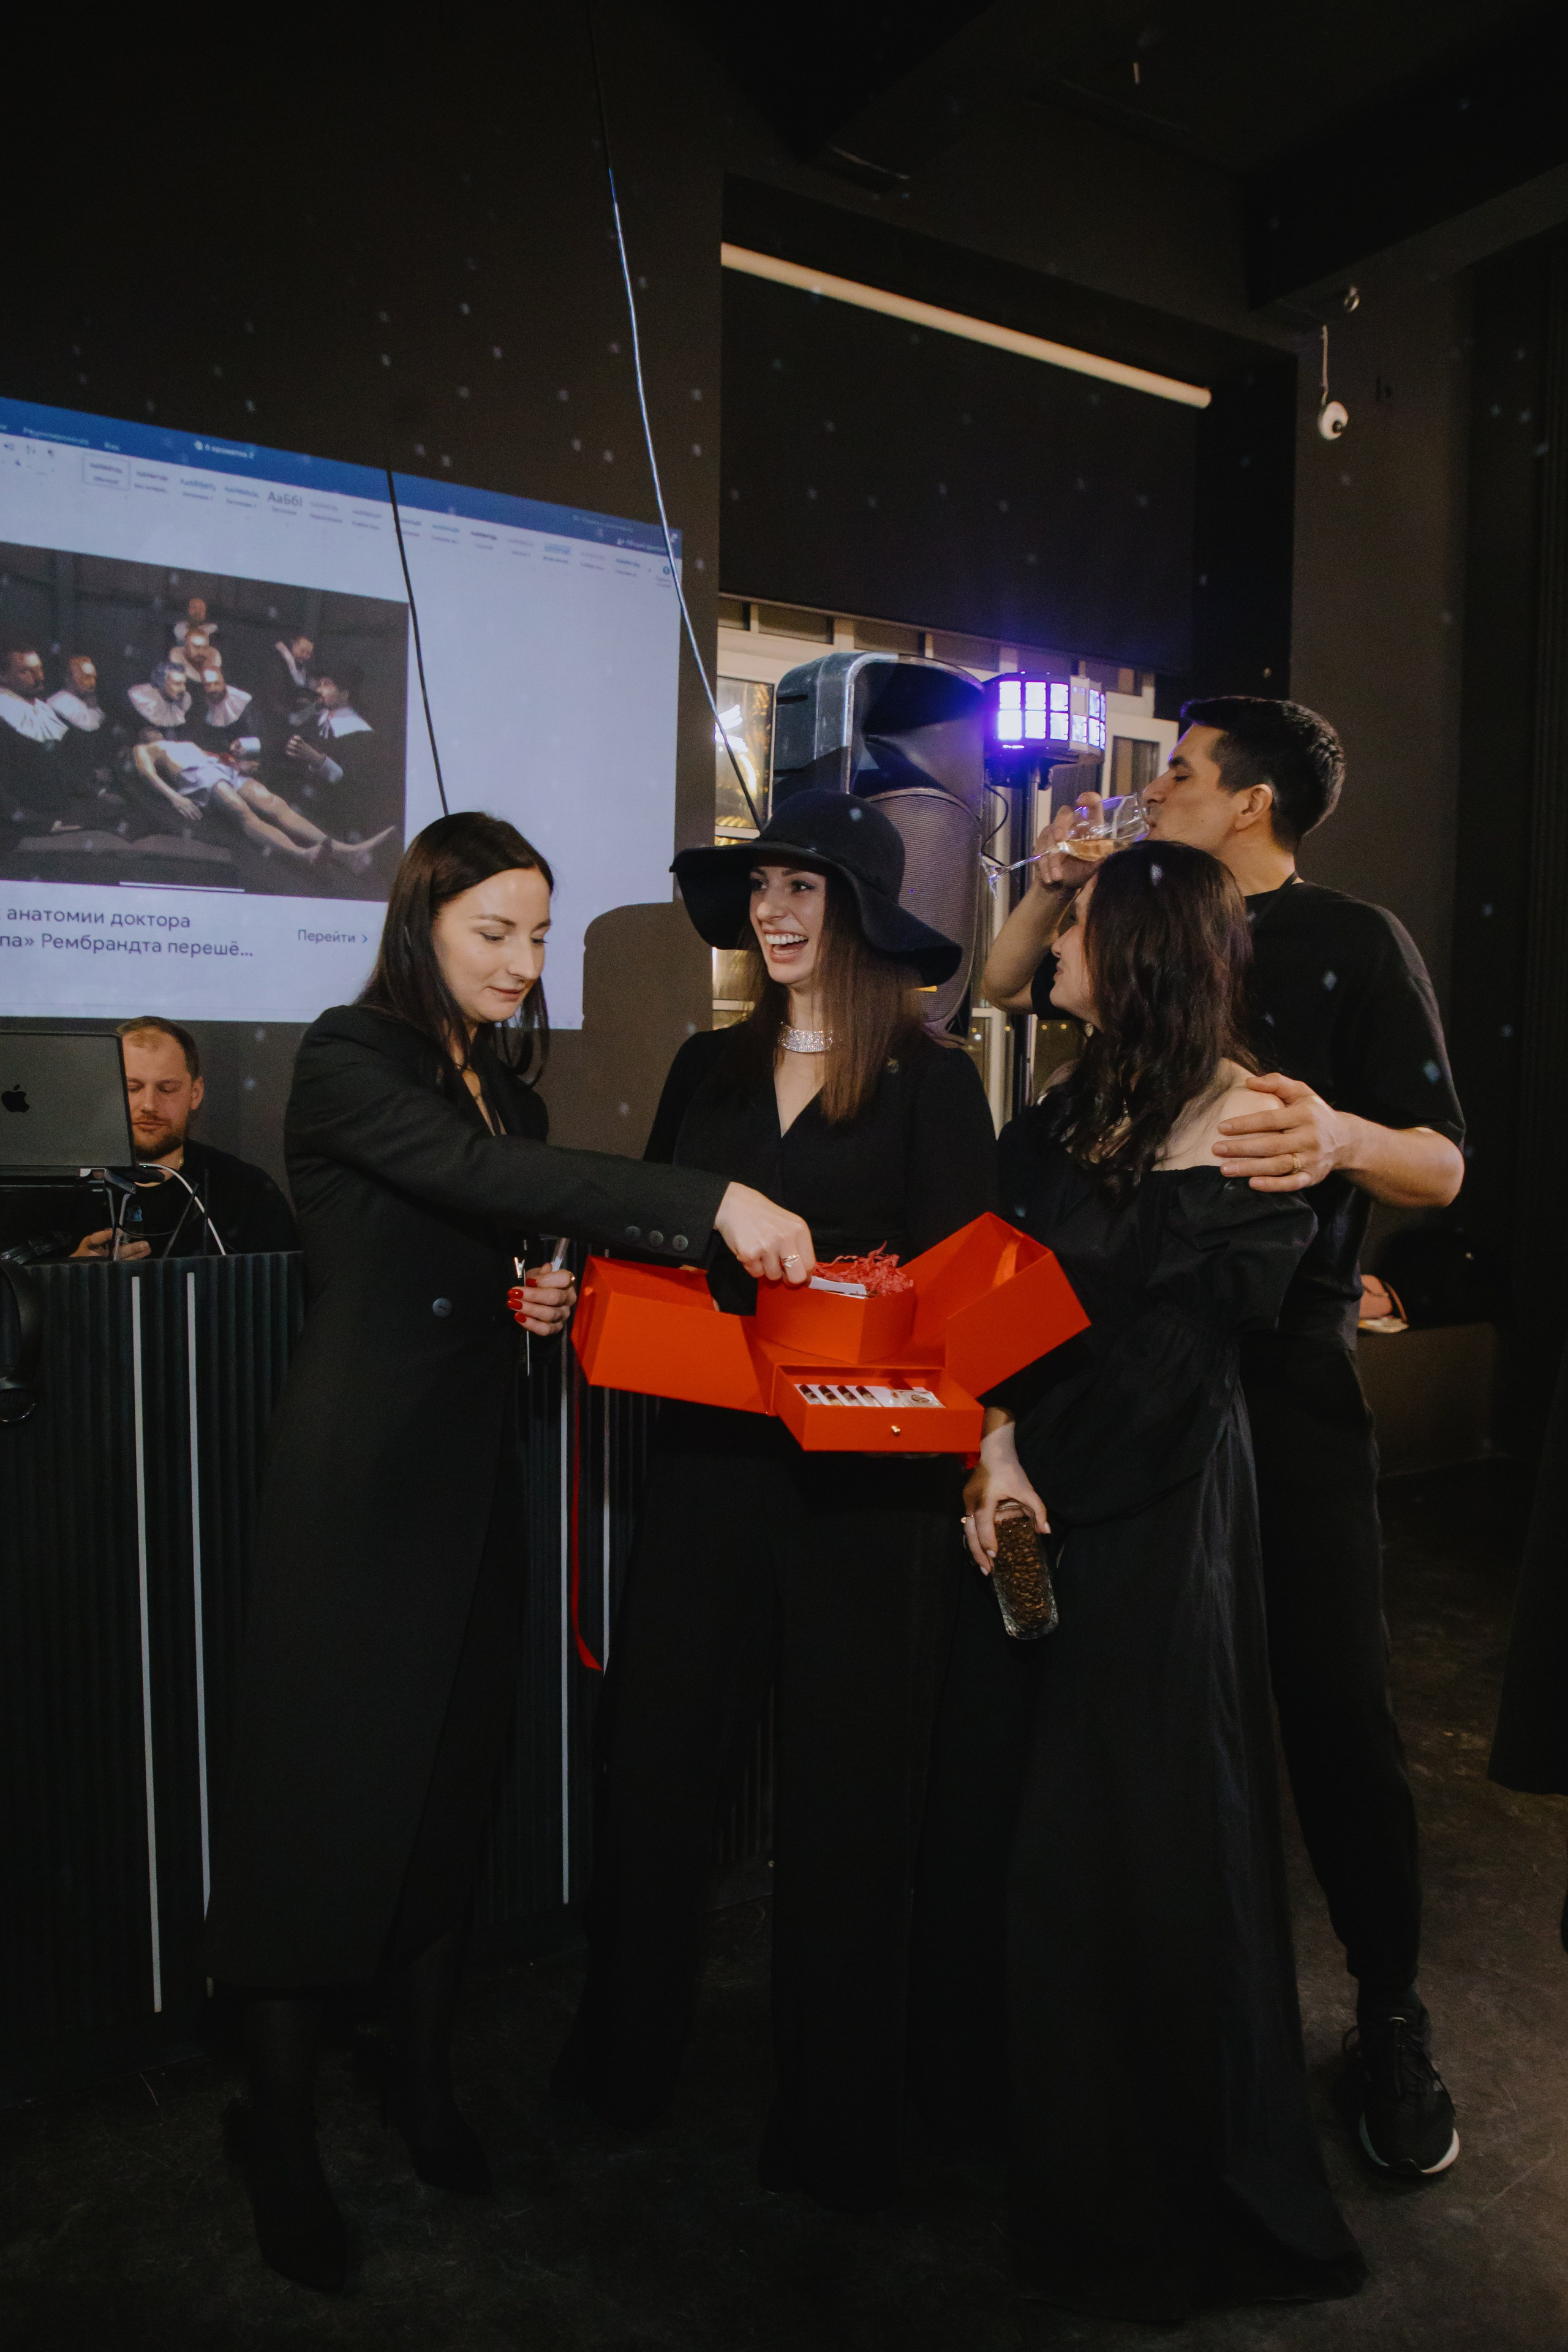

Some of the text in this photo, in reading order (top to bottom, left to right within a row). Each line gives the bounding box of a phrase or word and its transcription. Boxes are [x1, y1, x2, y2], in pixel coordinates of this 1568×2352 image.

[7, 908, 190, 931] анатомии доктора
[42, 933, 162, 954] Рембрандта
[298, 929, 355, 944] Перейти
